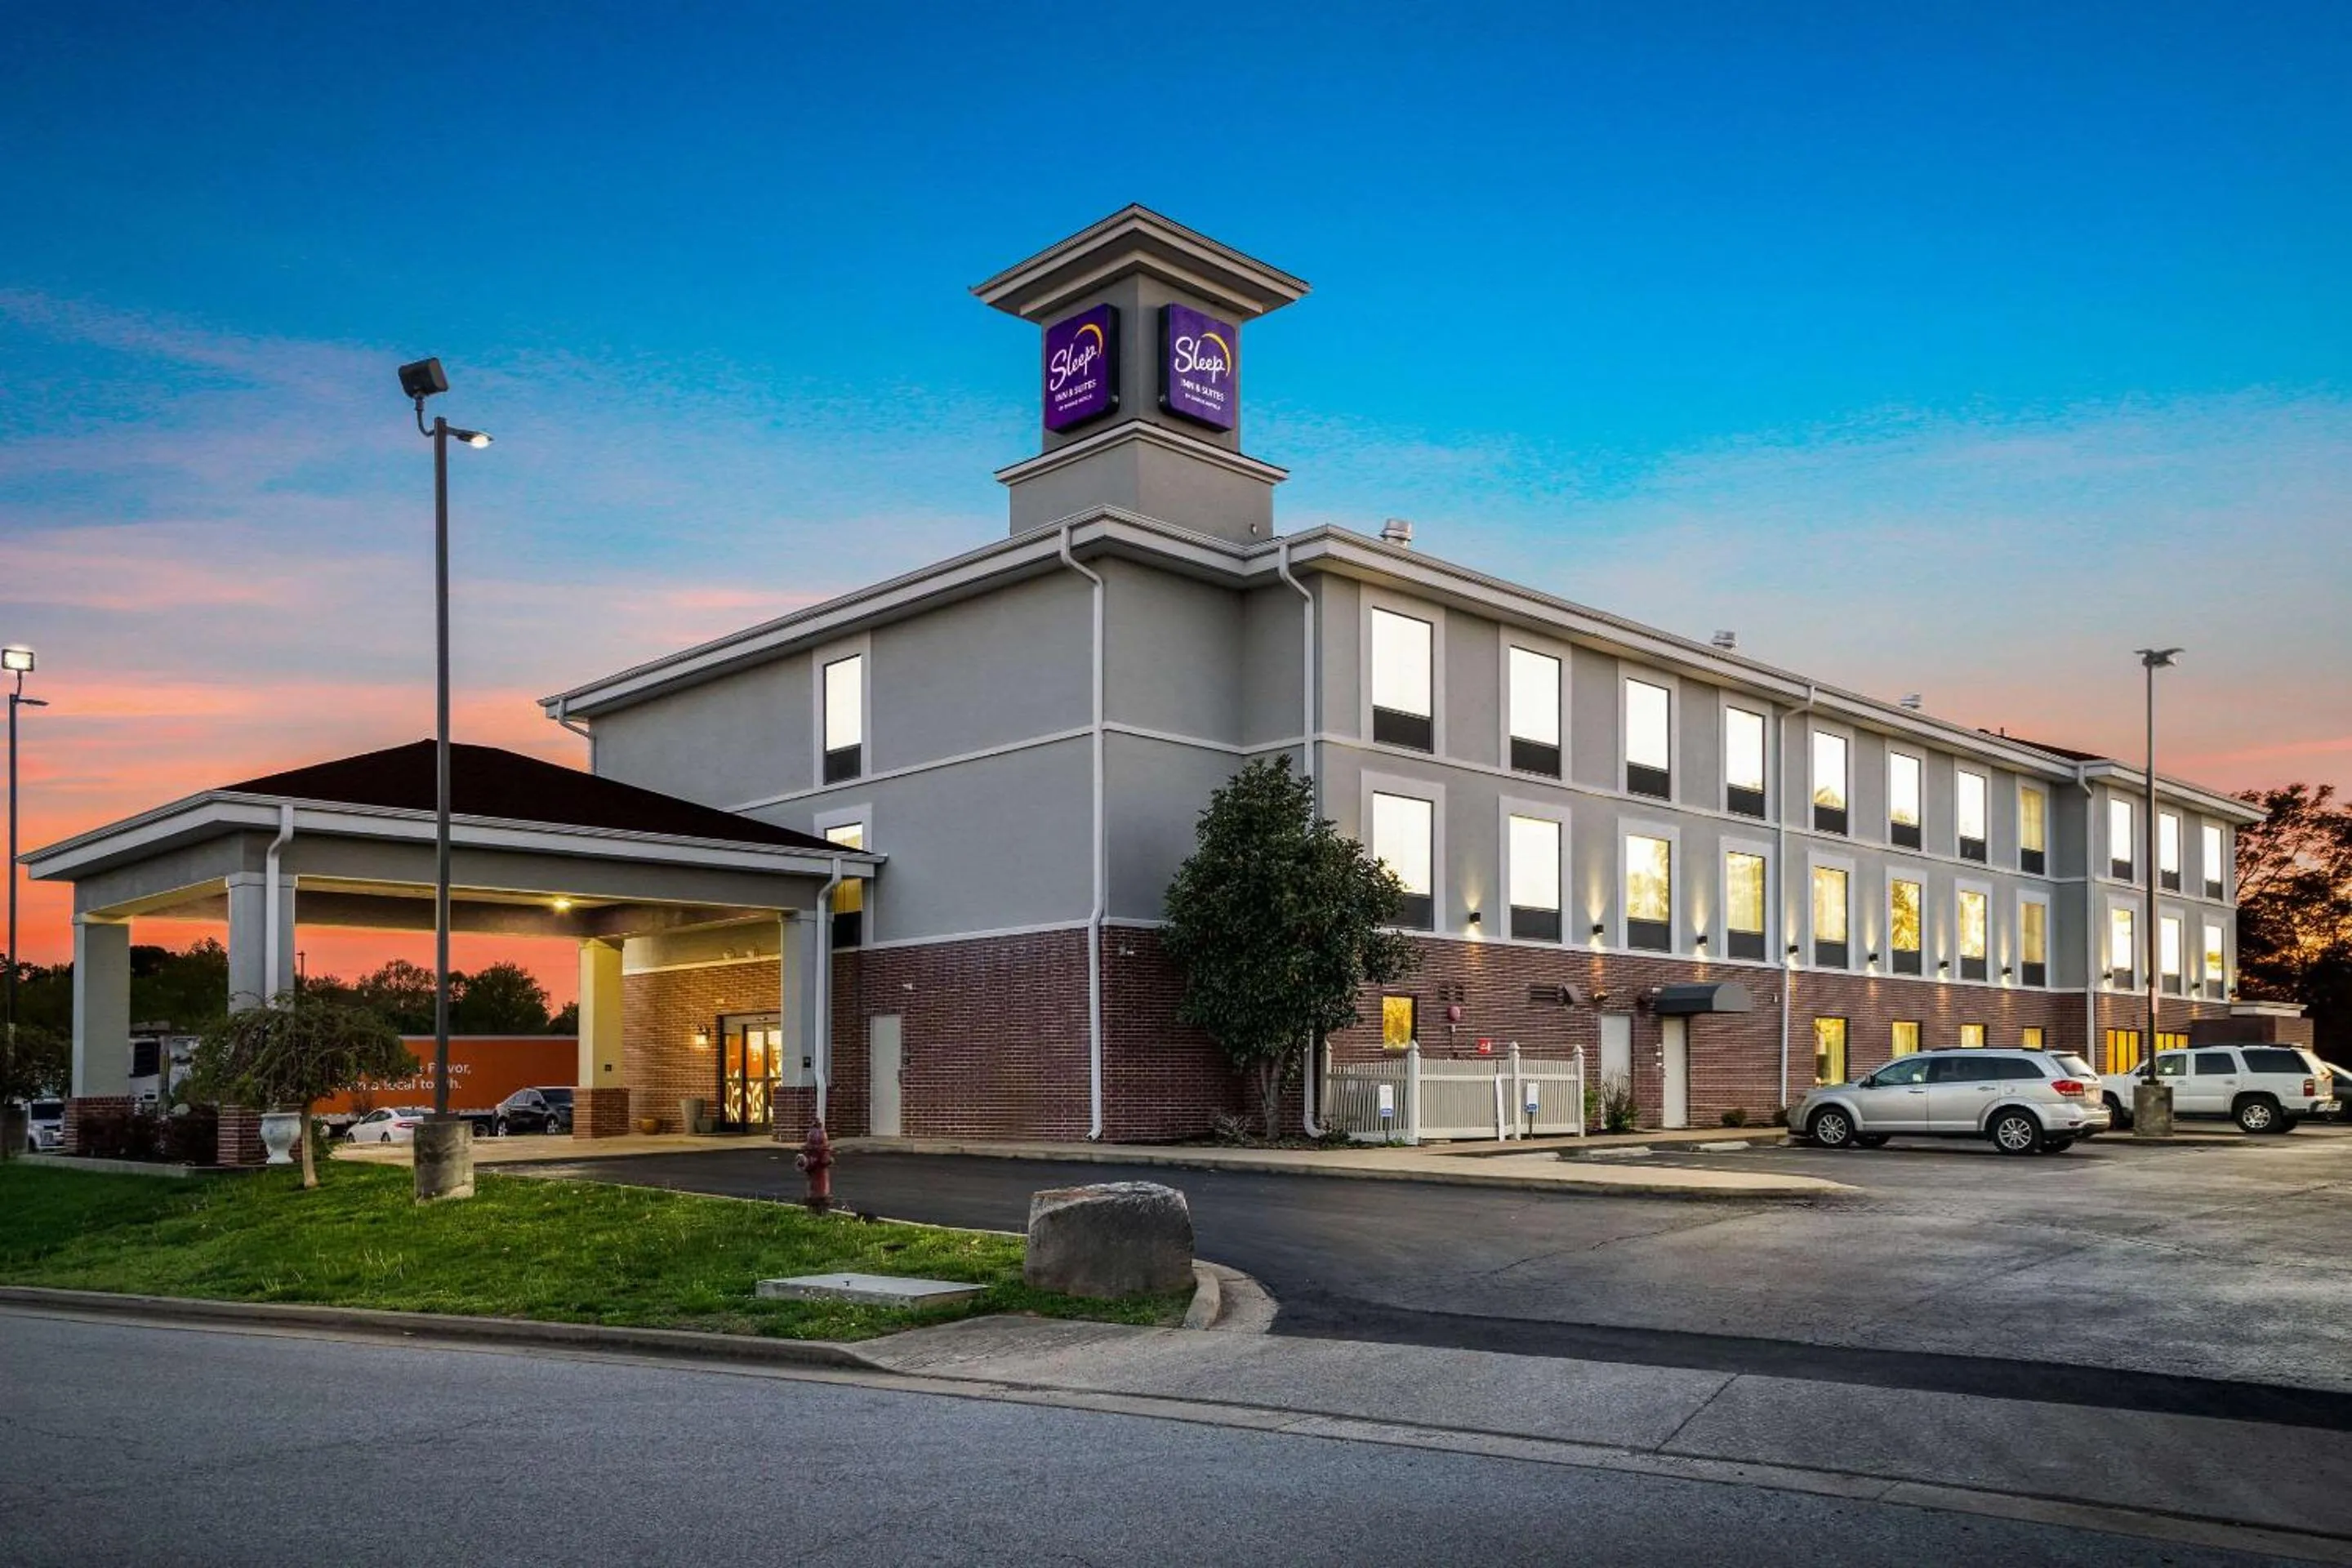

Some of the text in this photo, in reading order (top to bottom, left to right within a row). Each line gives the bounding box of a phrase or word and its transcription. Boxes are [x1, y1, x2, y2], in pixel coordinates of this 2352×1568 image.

[1050, 342, 1097, 391] Sleep
[1174, 336, 1226, 384] Sleep
[1074, 378, 1097, 395] SUITES
[1202, 385, 1224, 402] SUITES
[427, 1062, 471, 1075] Fvor,
[421, 1078, 461, 1090] toh.
